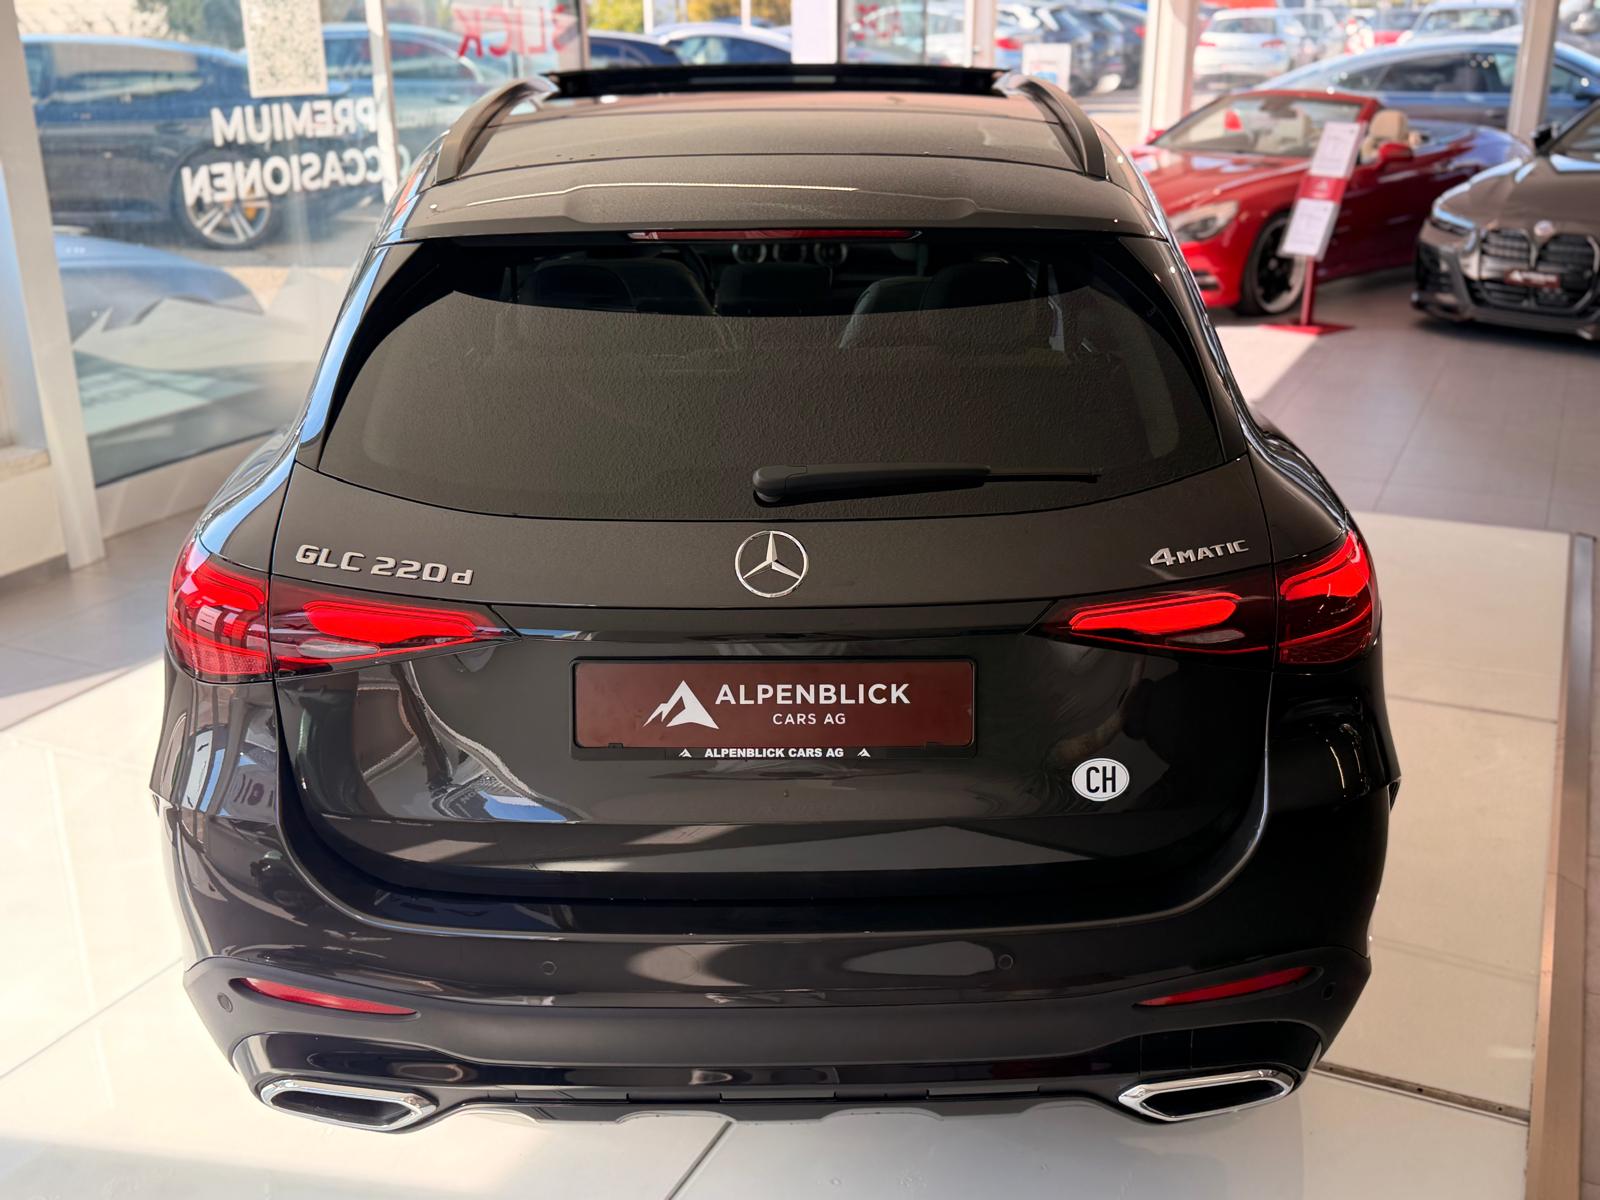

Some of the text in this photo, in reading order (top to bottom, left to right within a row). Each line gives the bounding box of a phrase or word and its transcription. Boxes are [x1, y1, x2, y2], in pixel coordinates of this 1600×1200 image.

[295, 544, 366, 572] GLC
[1149, 539, 1250, 567] 4MATIC
[714, 682, 911, 706] ALPENBLICK
[772, 712, 847, 726] CARS AG
[704, 747, 845, 759] ALPENBLICK CARS AG
[1085, 765, 1117, 794] CH
